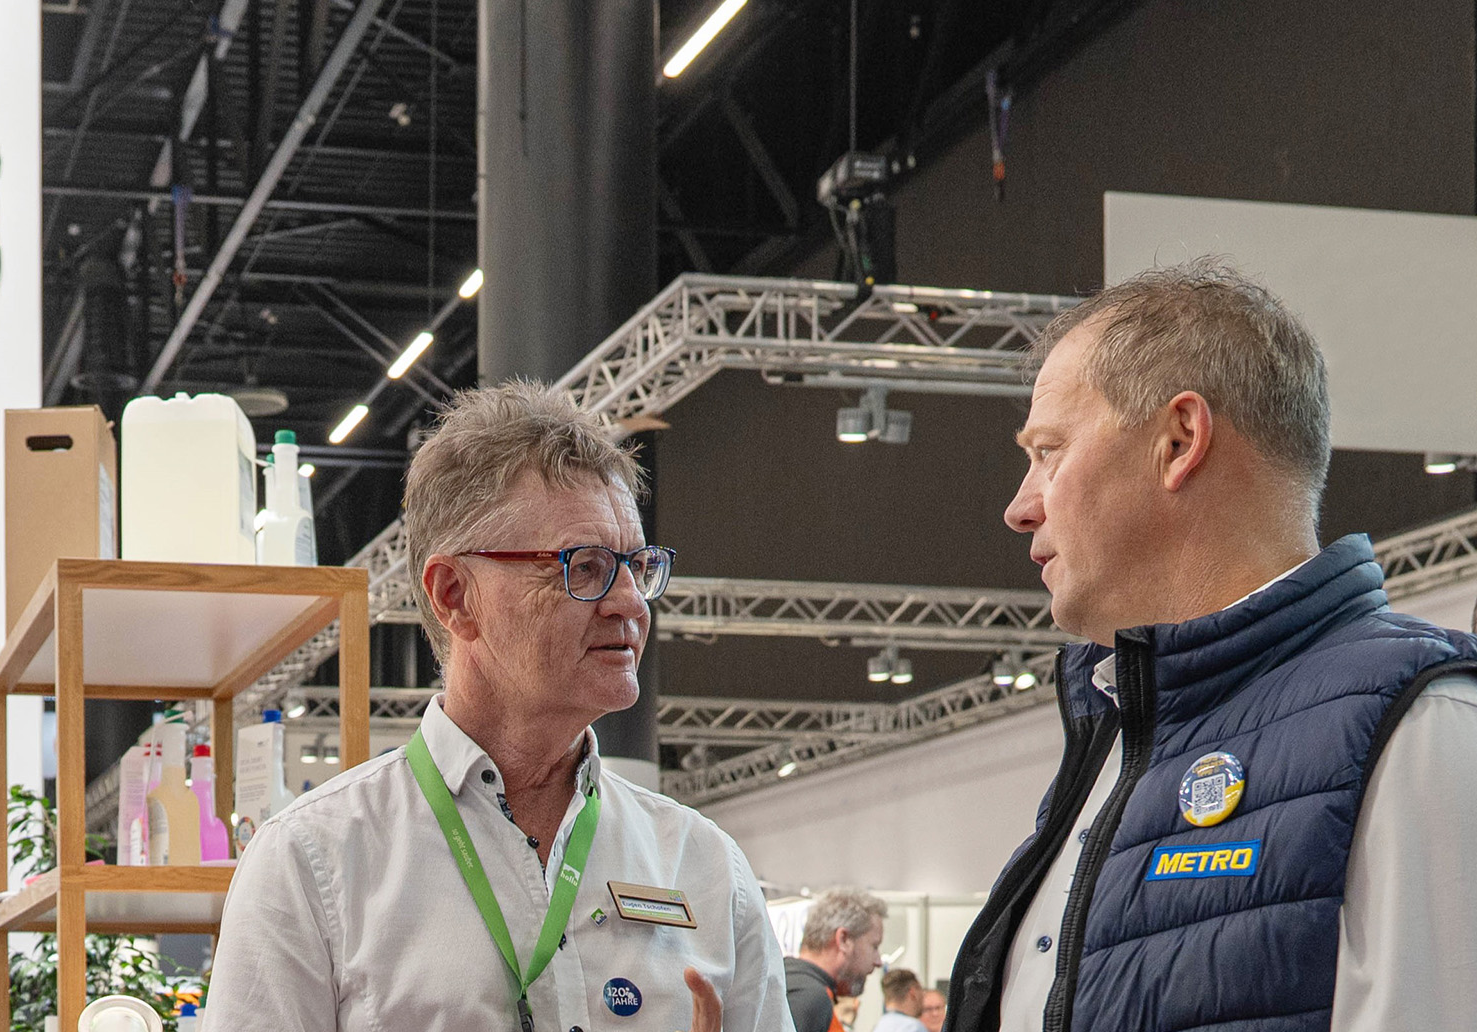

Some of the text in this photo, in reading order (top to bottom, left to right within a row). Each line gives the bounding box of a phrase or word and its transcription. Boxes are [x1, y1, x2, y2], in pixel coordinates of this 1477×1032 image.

[1154, 847, 1253, 876] METRO
[560, 870, 579, 887] hollu
[606, 986, 626, 998] 120
[612, 997, 639, 1006] JAHRE
